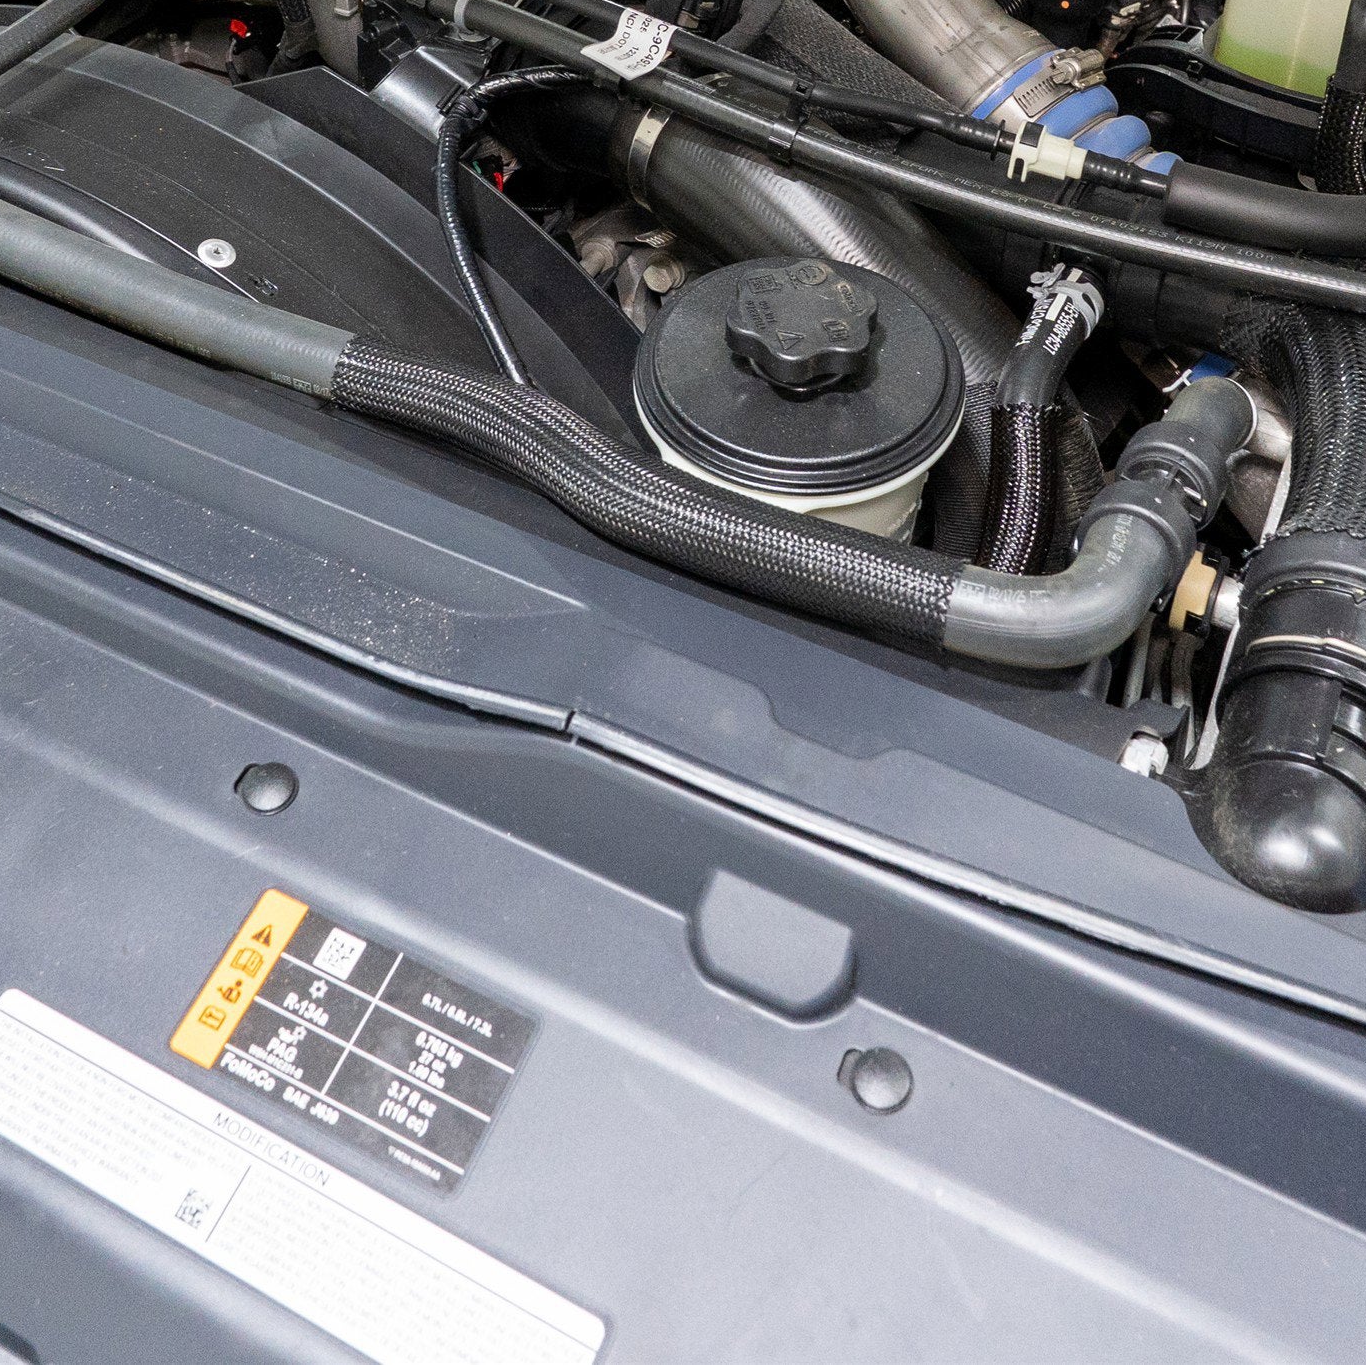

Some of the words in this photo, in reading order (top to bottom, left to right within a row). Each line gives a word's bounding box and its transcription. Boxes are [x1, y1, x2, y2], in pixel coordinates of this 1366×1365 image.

[283, 992, 329, 1027] R-134a
[266, 1037, 298, 1063] PAG
[441, 1046, 464, 1069] kg
[220, 1052, 281, 1091] FoMoCo
[283, 1086, 310, 1110] SAE
[387, 1081, 410, 1101] 3.7
[214, 1112, 330, 1186] MODIFICATION
